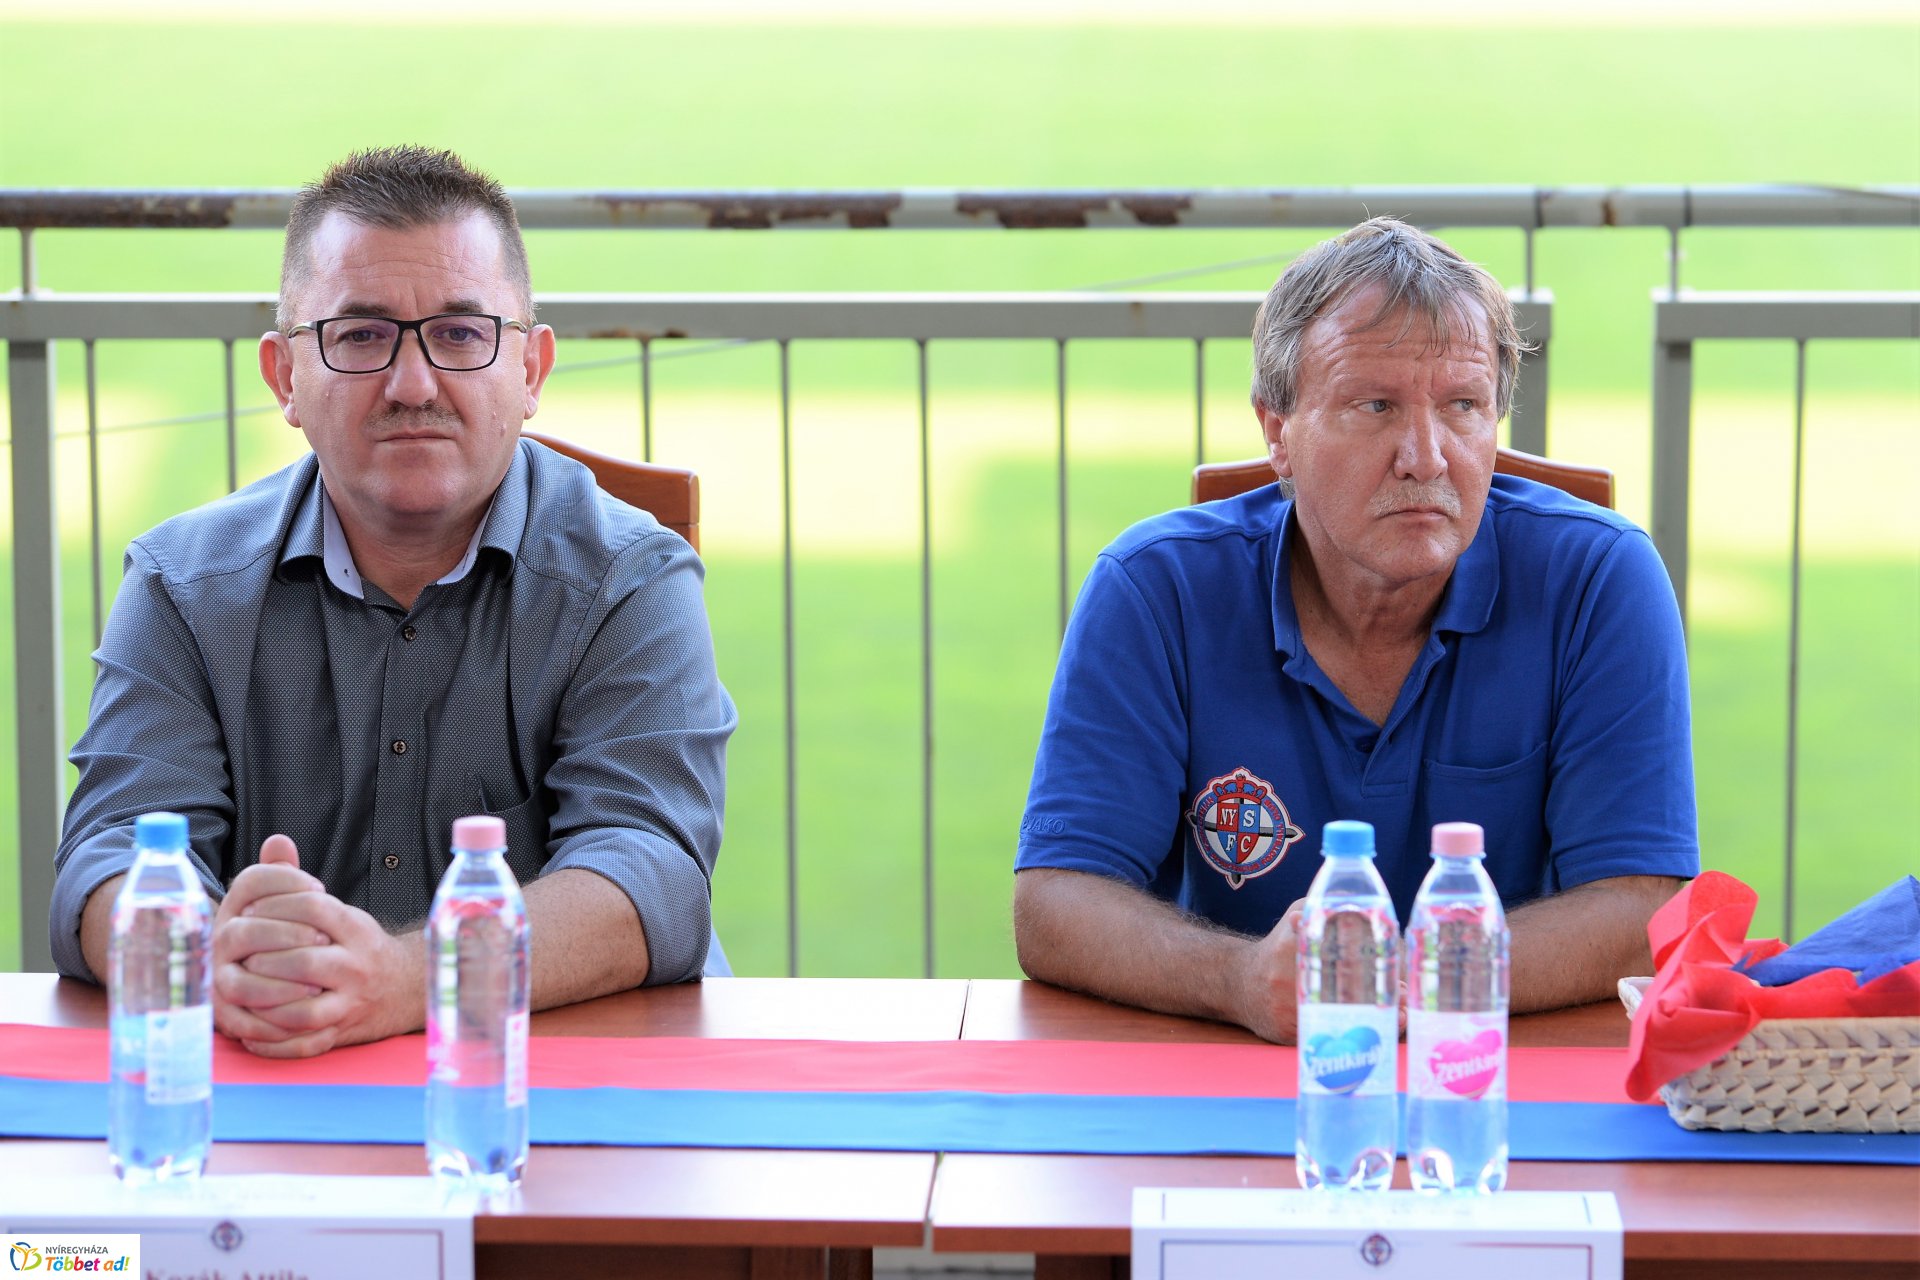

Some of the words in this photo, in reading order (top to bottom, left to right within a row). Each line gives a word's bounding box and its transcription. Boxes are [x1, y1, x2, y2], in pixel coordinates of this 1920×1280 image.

[1220, 808, 1237, 826] NY
[1243, 809, 1255, 828] S
[1225, 834, 1236, 851] F
[1240, 836, 1251, 853] C
